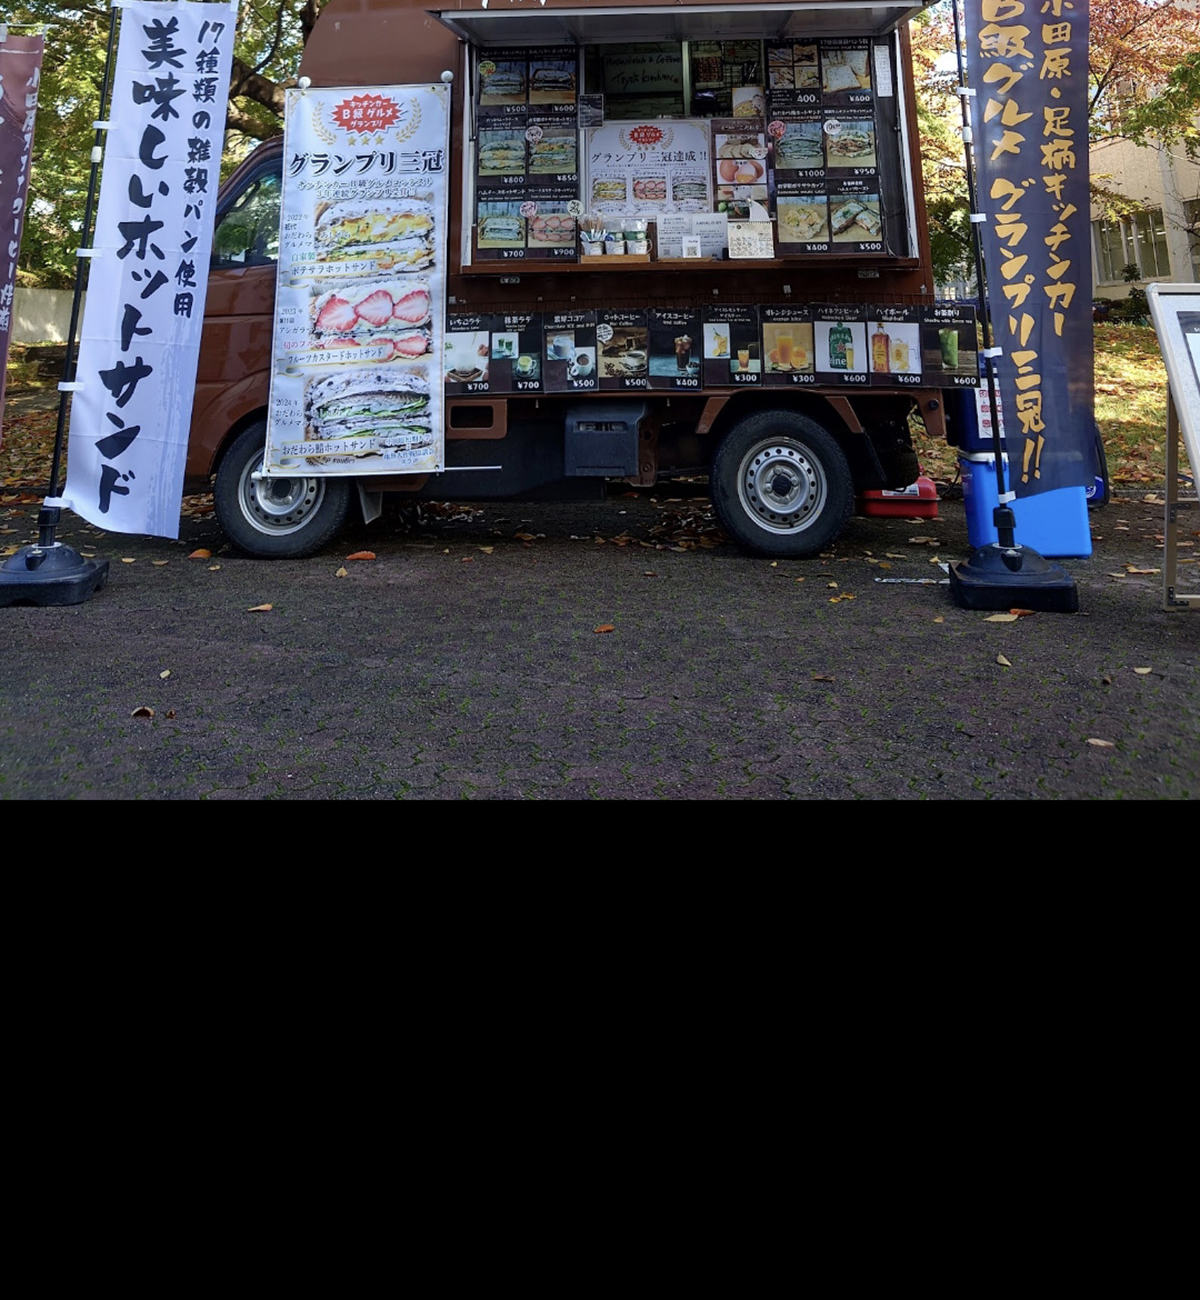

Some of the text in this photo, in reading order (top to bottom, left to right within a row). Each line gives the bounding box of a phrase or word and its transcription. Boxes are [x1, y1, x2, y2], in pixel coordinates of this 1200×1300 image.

[554, 104, 575, 112] ¥600
[350, 119, 384, 129] グランプリ
[290, 149, 444, 177] グランプリ三冠
[173, 20, 226, 321] 17種類の雑穀パン使用
[291, 251, 316, 261] 自家製
[98, 16, 189, 515] 美味しいホットサンド
[291, 260, 376, 276] ポテサラホットサンド
[876, 308, 910, 316] ハイボール
[504, 315, 532, 324] 抹茶ラテ
[554, 314, 585, 323] 濃厚ココア
[603, 313, 641, 321] ホットコーヒー
[450, 318, 482, 326] いちごラテ
[287, 347, 384, 364] フルーツカスタードホットサンド
[625, 378, 647, 386] ¥500
[676, 378, 698, 386] ¥400
[734, 374, 757, 382] ¥300
[792, 375, 815, 383] ¥300
[843, 374, 866, 382] ¥600
[898, 375, 921, 383] ¥600
[953, 377, 977, 385] ¥600
[467, 382, 489, 390] ¥700
[517, 381, 539, 389] ¥700
[573, 379, 595, 387] ¥500
